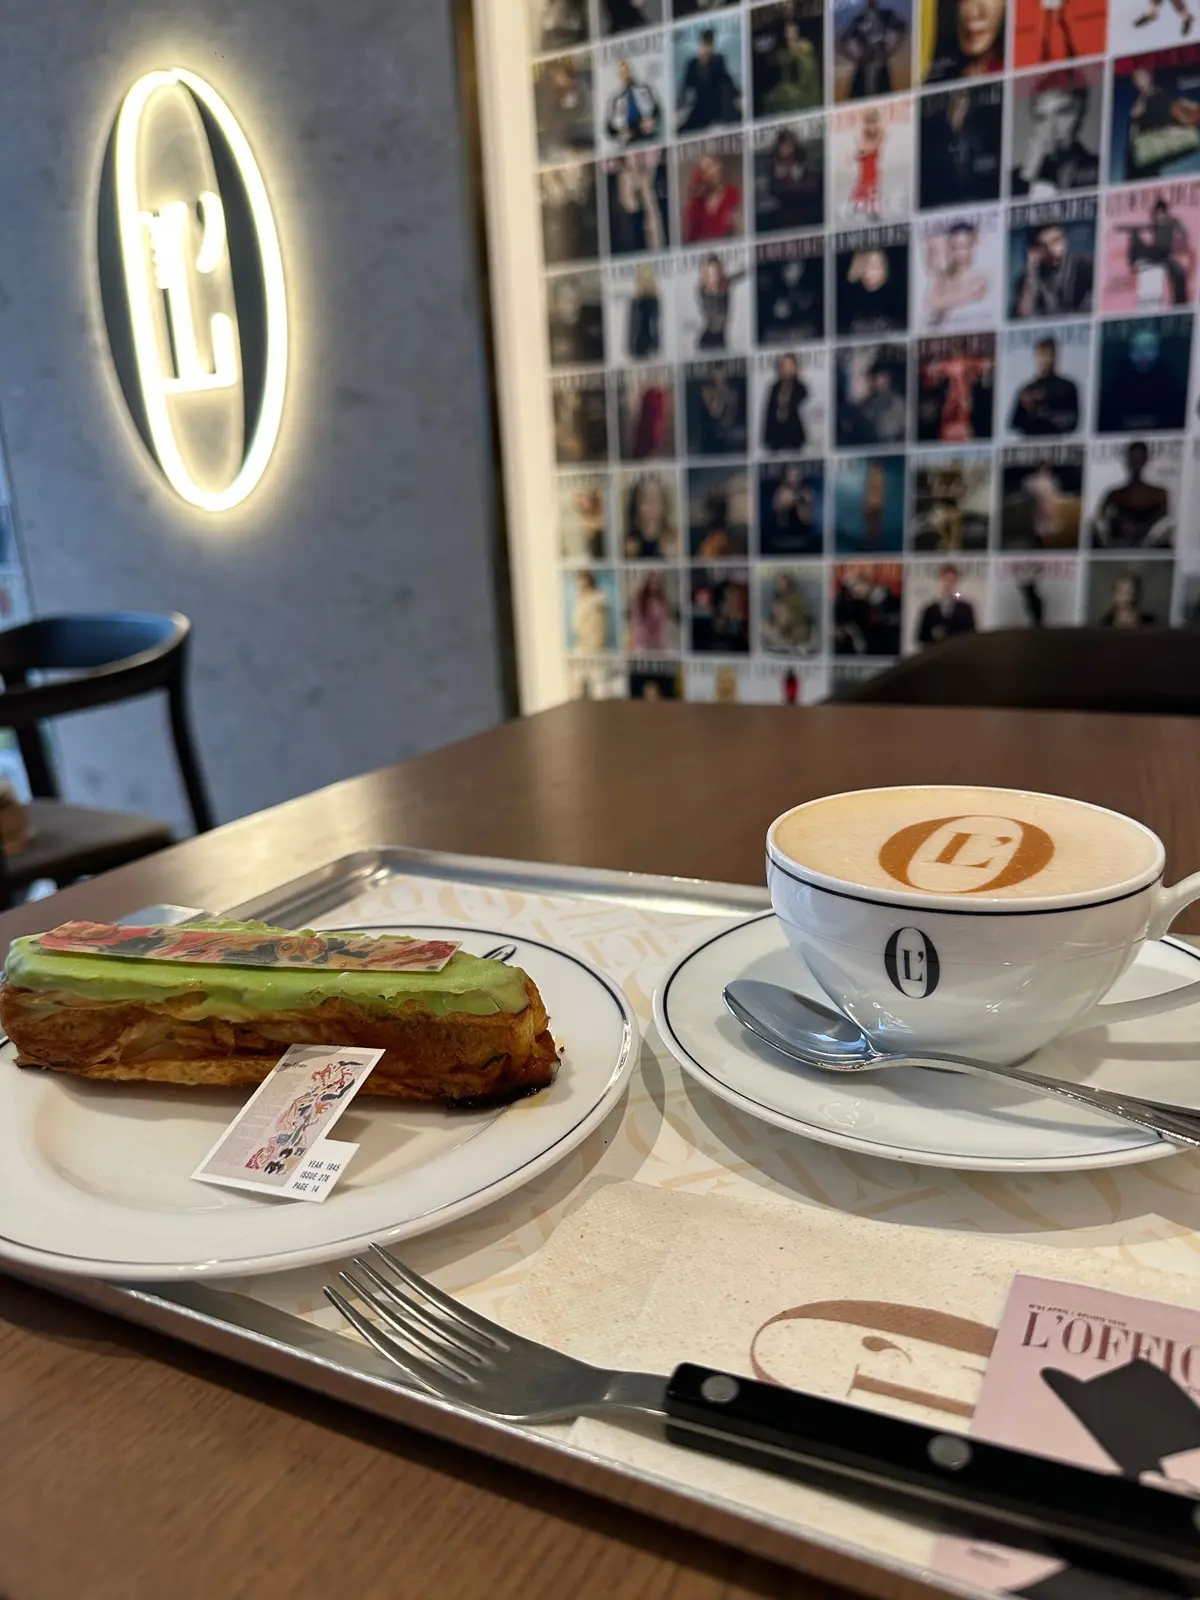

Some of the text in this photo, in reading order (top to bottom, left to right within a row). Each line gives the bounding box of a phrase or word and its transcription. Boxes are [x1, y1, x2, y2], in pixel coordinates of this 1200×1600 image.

[308, 1160, 341, 1171] YEAR 1945
[300, 1171, 318, 1180] ISSUE
[292, 1181, 309, 1191] PAGE
